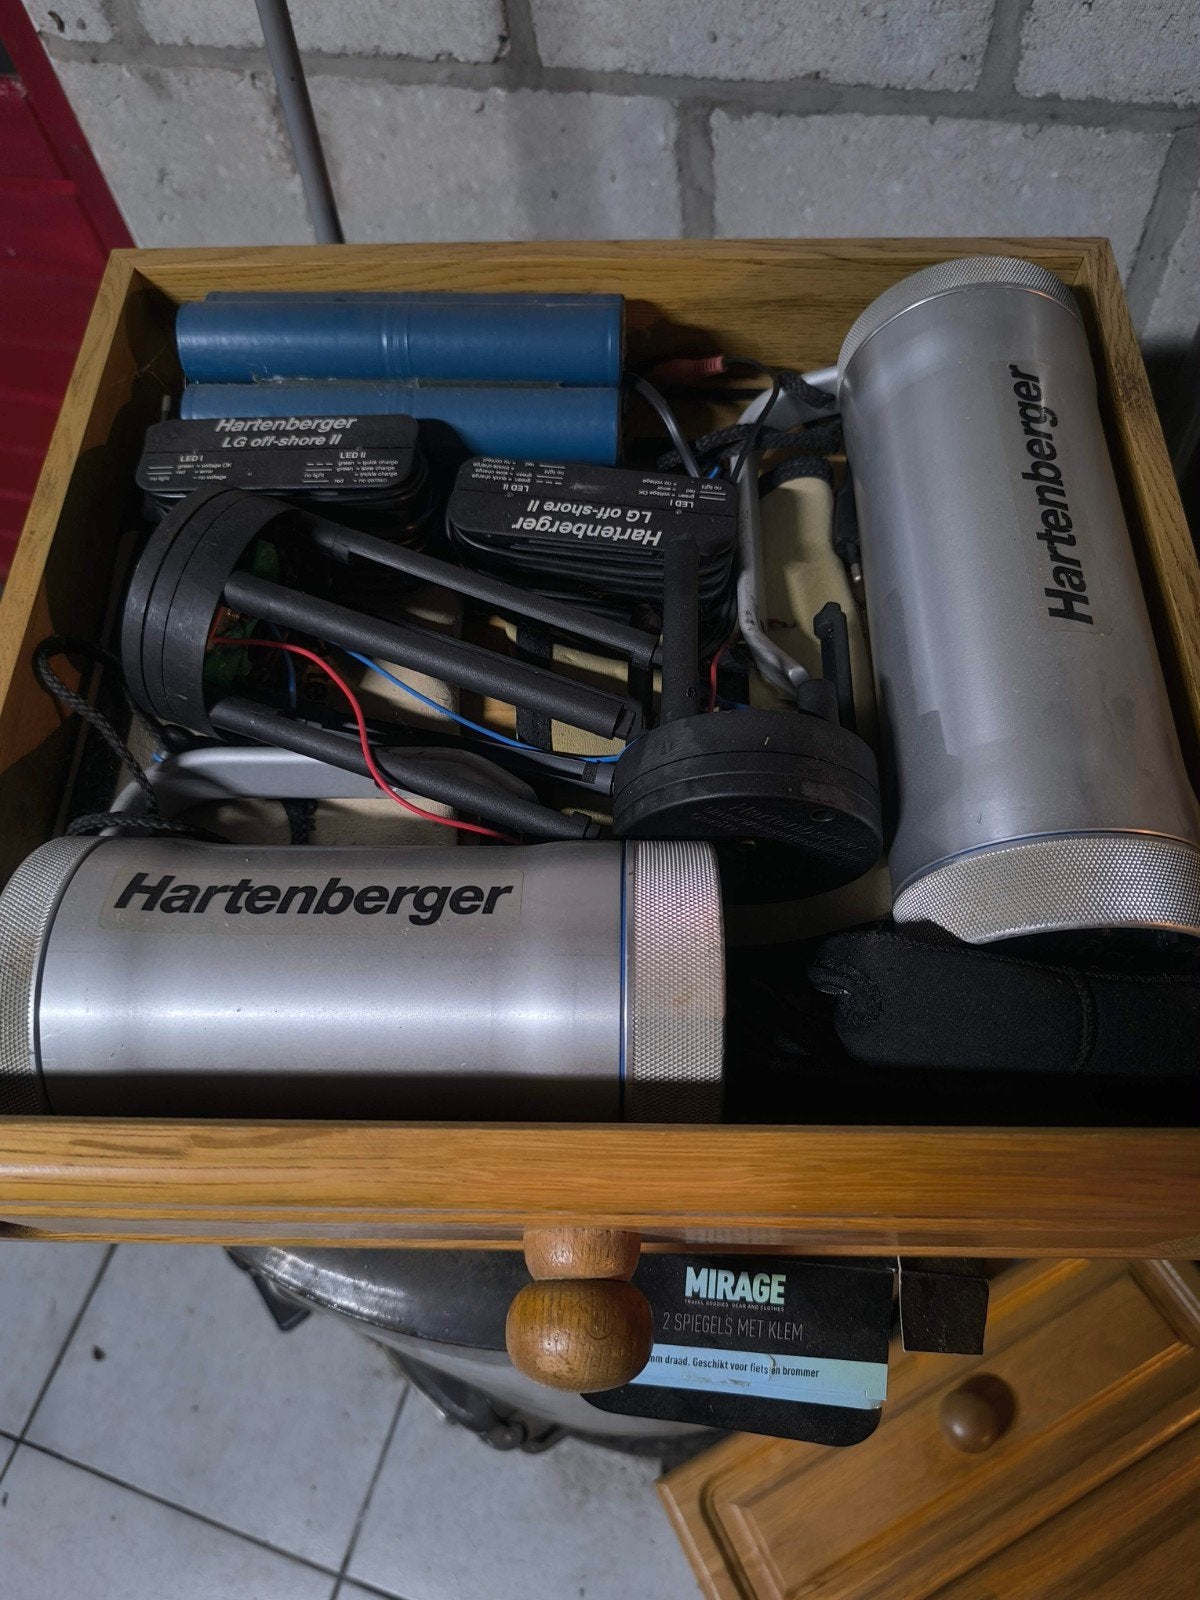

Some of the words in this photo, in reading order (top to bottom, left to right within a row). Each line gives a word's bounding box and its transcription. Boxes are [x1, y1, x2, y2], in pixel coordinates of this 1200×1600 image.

[215, 417, 357, 434] Hartenberger
[222, 437, 248, 448] LG
[250, 435, 327, 447] off-shore
[329, 434, 343, 445] II
[180, 455, 199, 463] LED
[339, 451, 359, 459] LED
[360, 451, 367, 459] II
[510, 484, 529, 493] LED
[1008, 364, 1094, 625] Hartenberger
[543, 501, 622, 520] off-shore
[675, 500, 694, 509] LED
[628, 508, 653, 523] LG
[511, 515, 663, 547] Hartenberger
[114, 871, 513, 926] Hartenberger
[685, 1266, 787, 1305] MIRAGE
[662, 1312, 670, 1331] 2
[673, 1312, 733, 1335] SPIEGELS
[737, 1319, 766, 1338] MET
[768, 1320, 804, 1341] KLEM
[664, 1355, 690, 1366] draad.
[692, 1356, 729, 1369] Geschikt
[730, 1362, 748, 1372] voor
[750, 1362, 769, 1374] fiets
[771, 1366, 781, 1375] en
[782, 1366, 820, 1378] brommer
